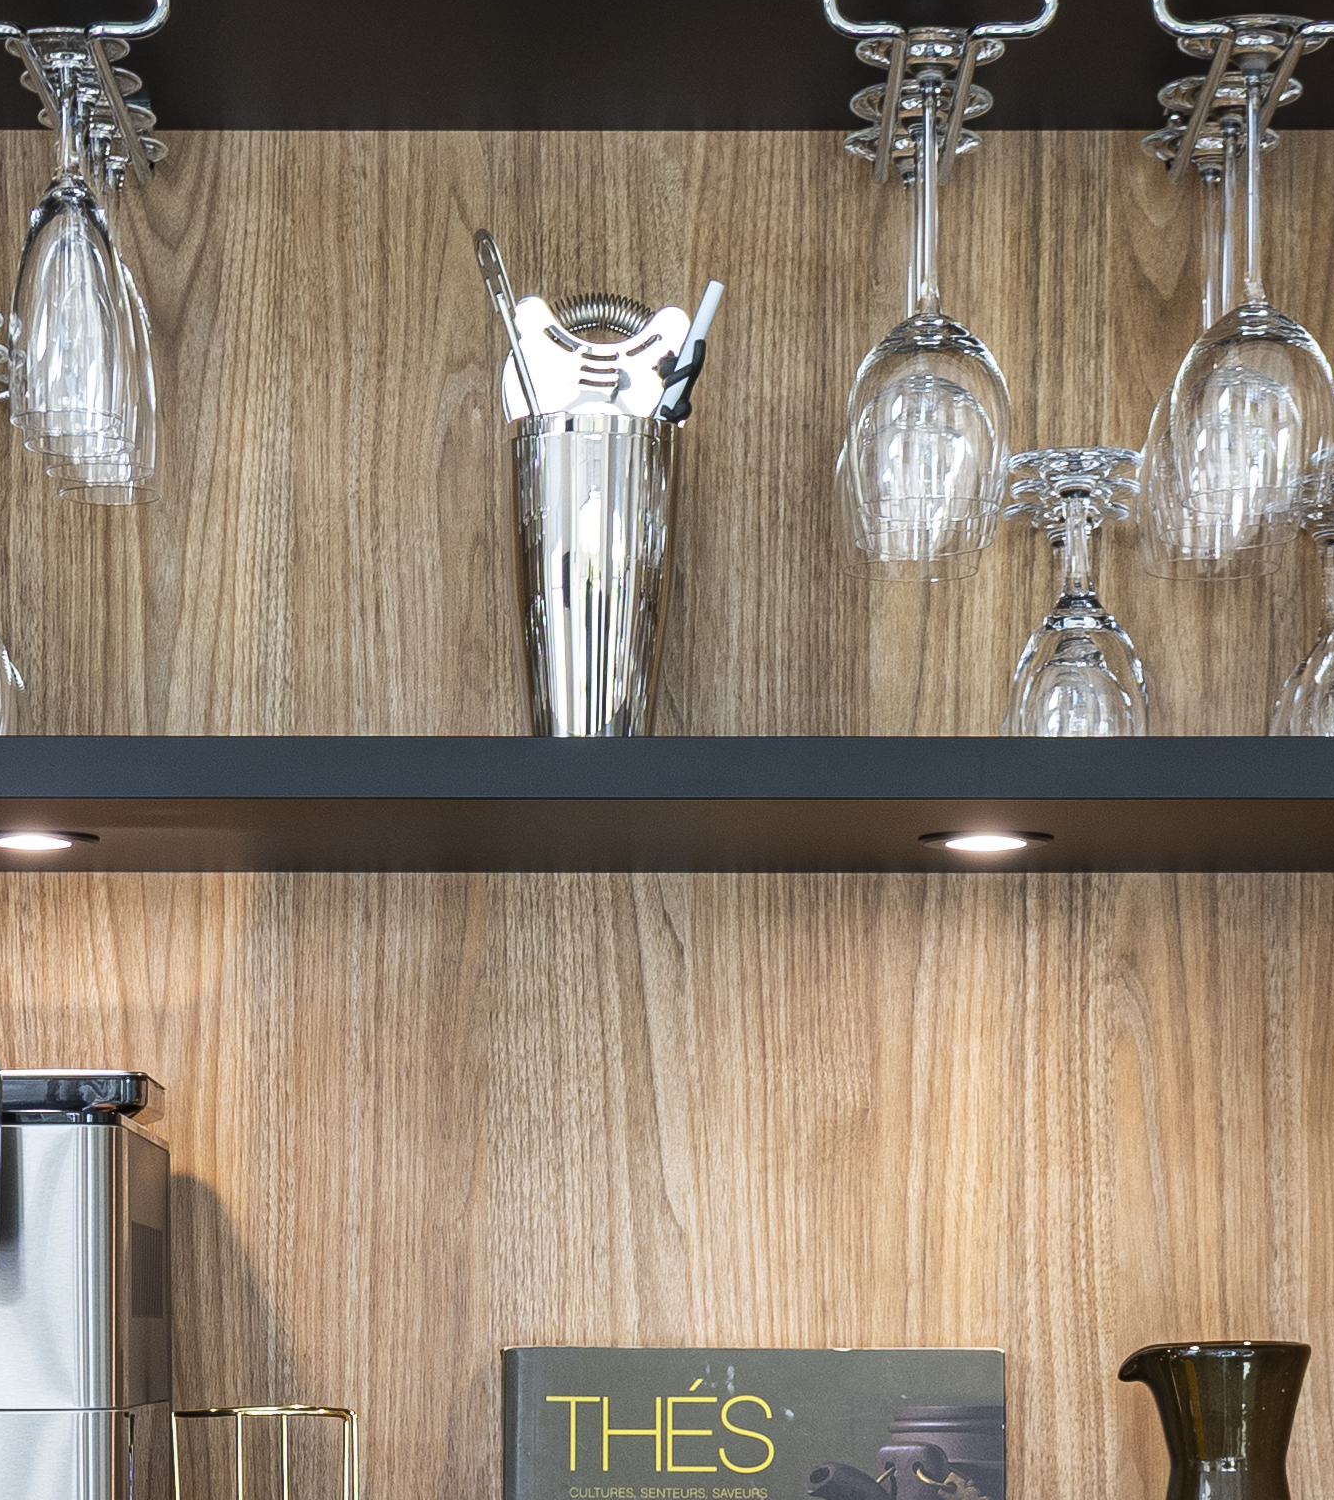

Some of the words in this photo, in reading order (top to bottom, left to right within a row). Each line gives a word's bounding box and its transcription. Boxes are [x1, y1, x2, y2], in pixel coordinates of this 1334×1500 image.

[546, 1379, 775, 1474] THÉS
[569, 1486, 637, 1500] CULTURES,
[640, 1487, 708, 1500] SENTEURS,
[712, 1487, 768, 1499] SAVEURS
